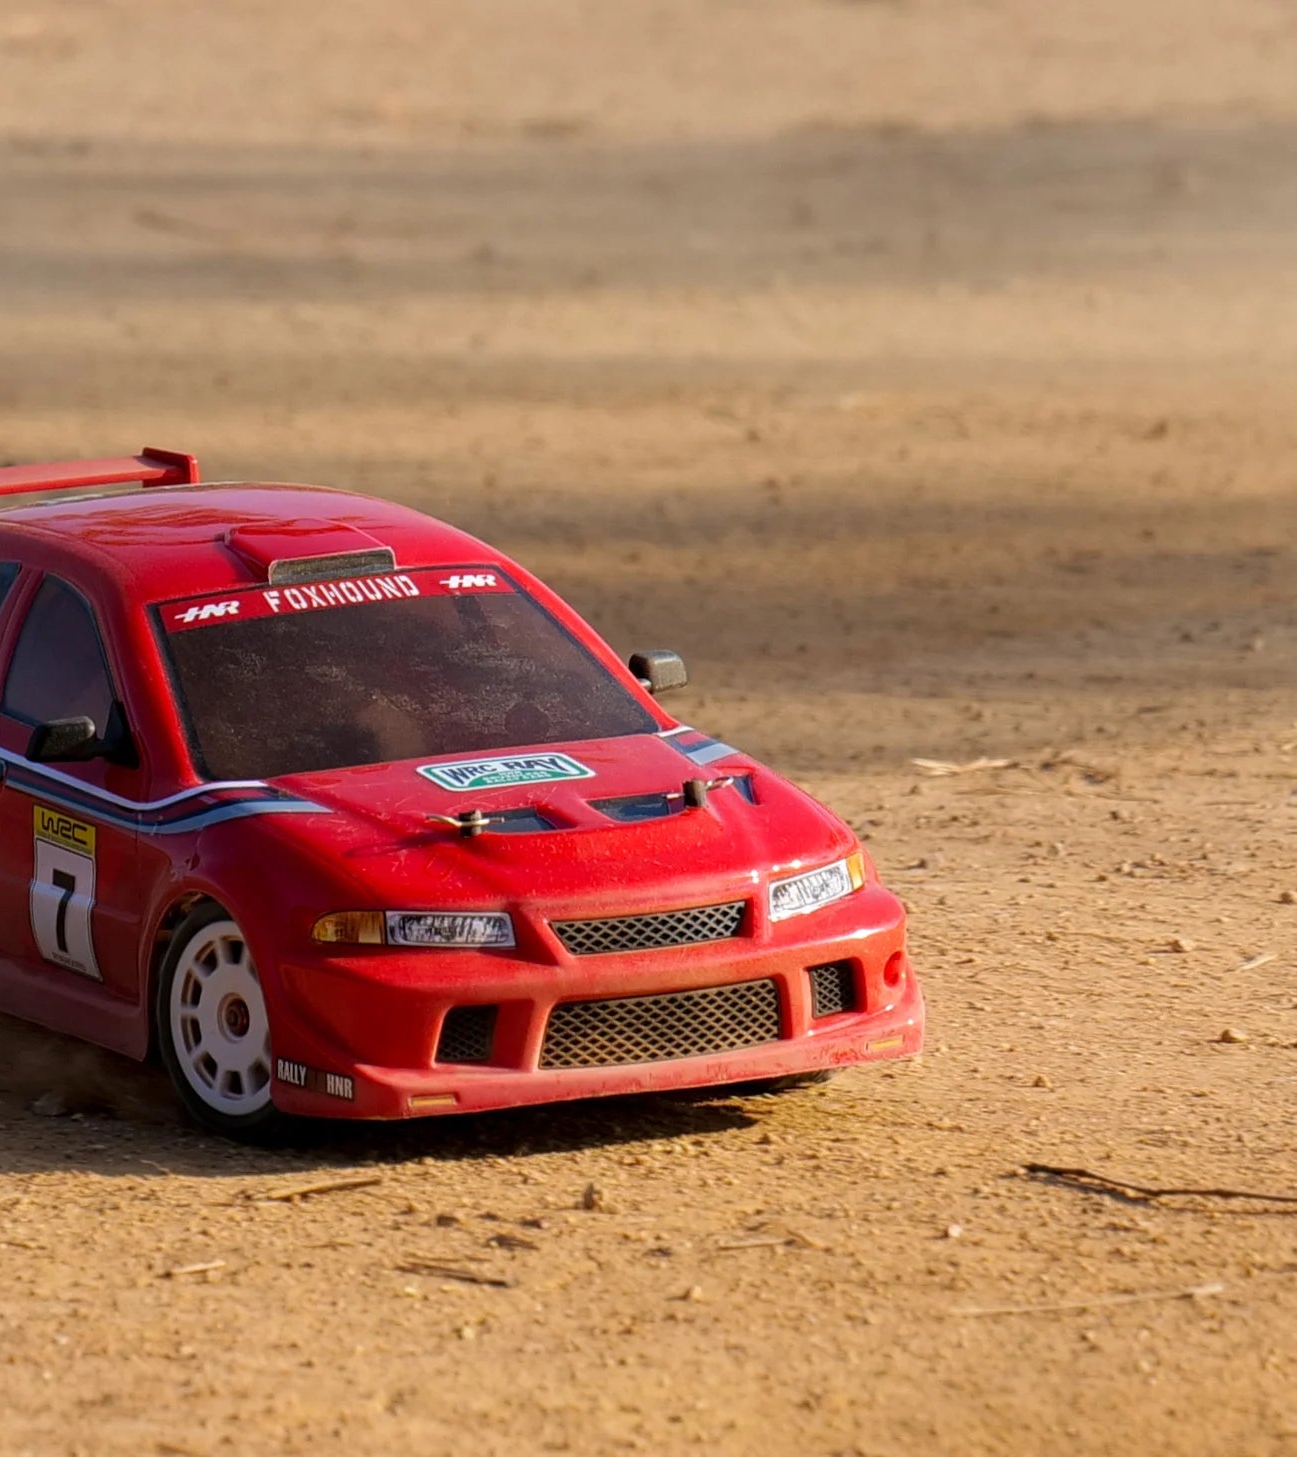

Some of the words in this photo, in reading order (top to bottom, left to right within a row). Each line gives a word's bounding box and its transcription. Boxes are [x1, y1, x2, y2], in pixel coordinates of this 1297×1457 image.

[174, 600, 240, 623] HNR
[262, 575, 420, 613] FOXHOUND
[439, 574, 498, 589] HNR
[440, 763, 498, 786] WRC
[500, 757, 573, 774] RAY
[41, 810, 88, 846] WRC
[52, 867, 77, 954] 7
[277, 1058, 307, 1087] RALLY
[326, 1073, 353, 1100] HNR
